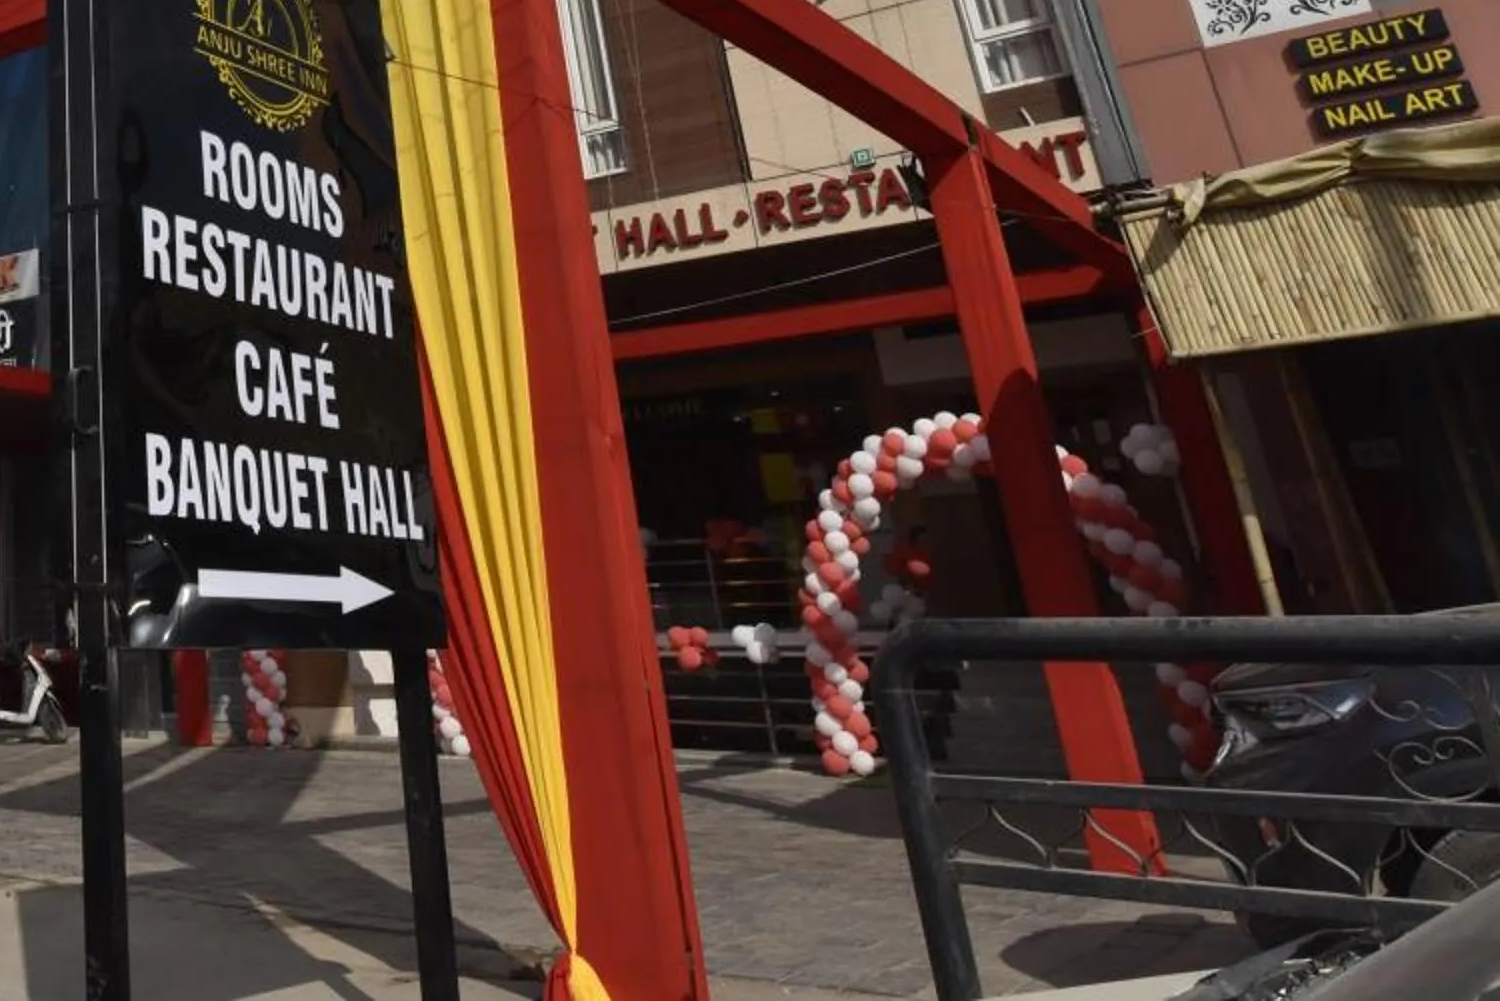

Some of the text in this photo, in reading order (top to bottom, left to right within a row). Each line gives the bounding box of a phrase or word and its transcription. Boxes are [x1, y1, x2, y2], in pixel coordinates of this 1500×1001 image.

[198, 25, 328, 94] ANJU SHREE INN
[1306, 13, 1426, 60] BEAUTY
[1323, 83, 1464, 130] NAIL ART
[200, 129, 344, 239] ROOMS
[615, 202, 730, 261] HALL
[141, 205, 395, 339] RESTAURANT
[235, 341, 341, 429] CAFÉ
[145, 432, 424, 541] BANQUET HALL
